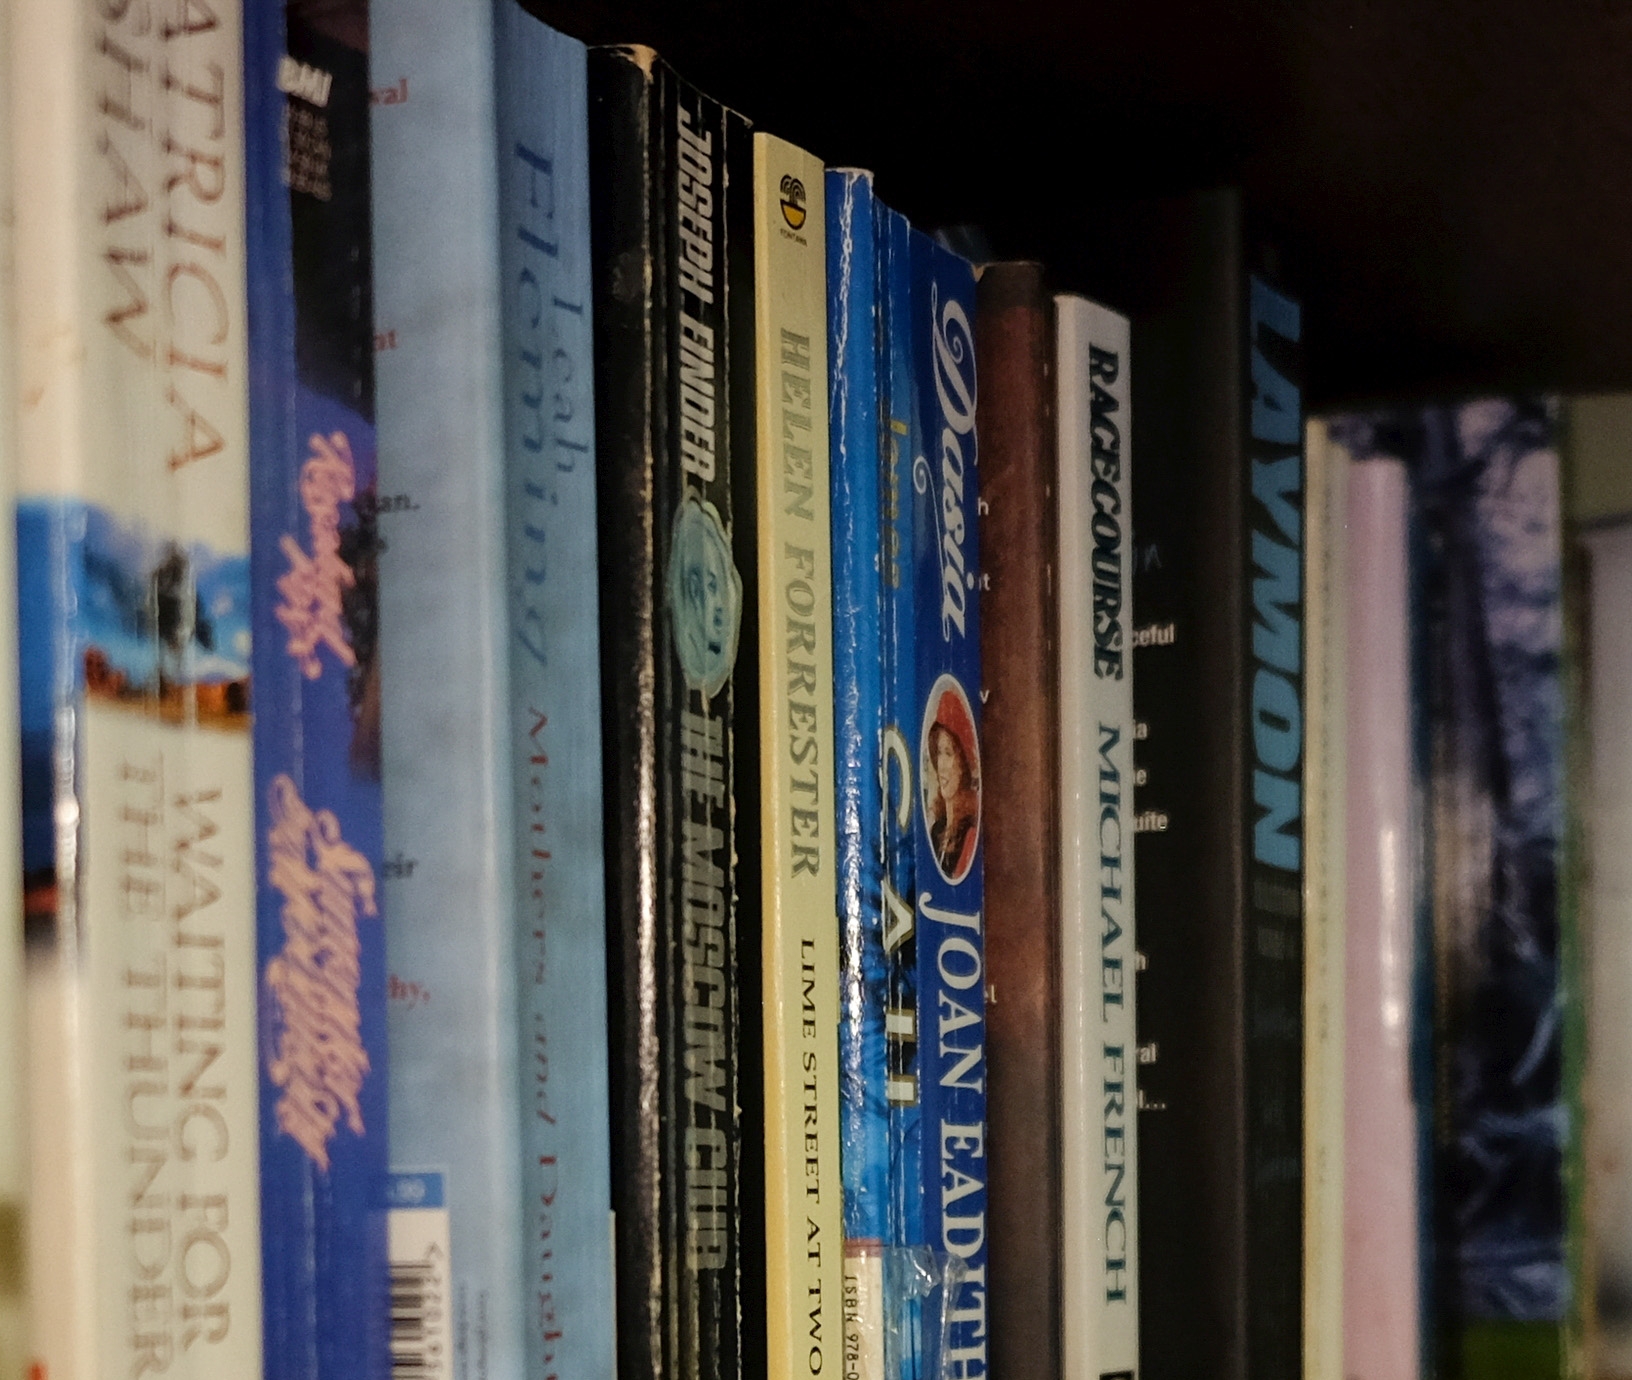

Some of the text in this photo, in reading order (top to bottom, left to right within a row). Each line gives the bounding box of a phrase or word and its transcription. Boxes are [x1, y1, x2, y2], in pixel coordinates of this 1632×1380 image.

[514, 142, 561, 669] Fleming
[550, 294, 590, 474] Leah
[677, 106, 716, 482] JOSEPH FINDER
[918, 279, 980, 643] Dasia
[779, 327, 824, 879] HELEN FORRESTER
[1249, 272, 1303, 873] LAYMON
[119, 750, 167, 923] THE
[679, 709, 726, 804] THE
[1088, 341, 1128, 1306] RACECOURSE MICHAEL FRENCH
[172, 787, 230, 1162] WAITING
[680, 820, 726, 1114] MOSCOW
[919, 891, 982, 1094] JOAN
[176, 1191, 233, 1352] FOR
[798, 937, 825, 1377] LIME STREET AT TWO
[844, 1273, 859, 1323] ISBN
